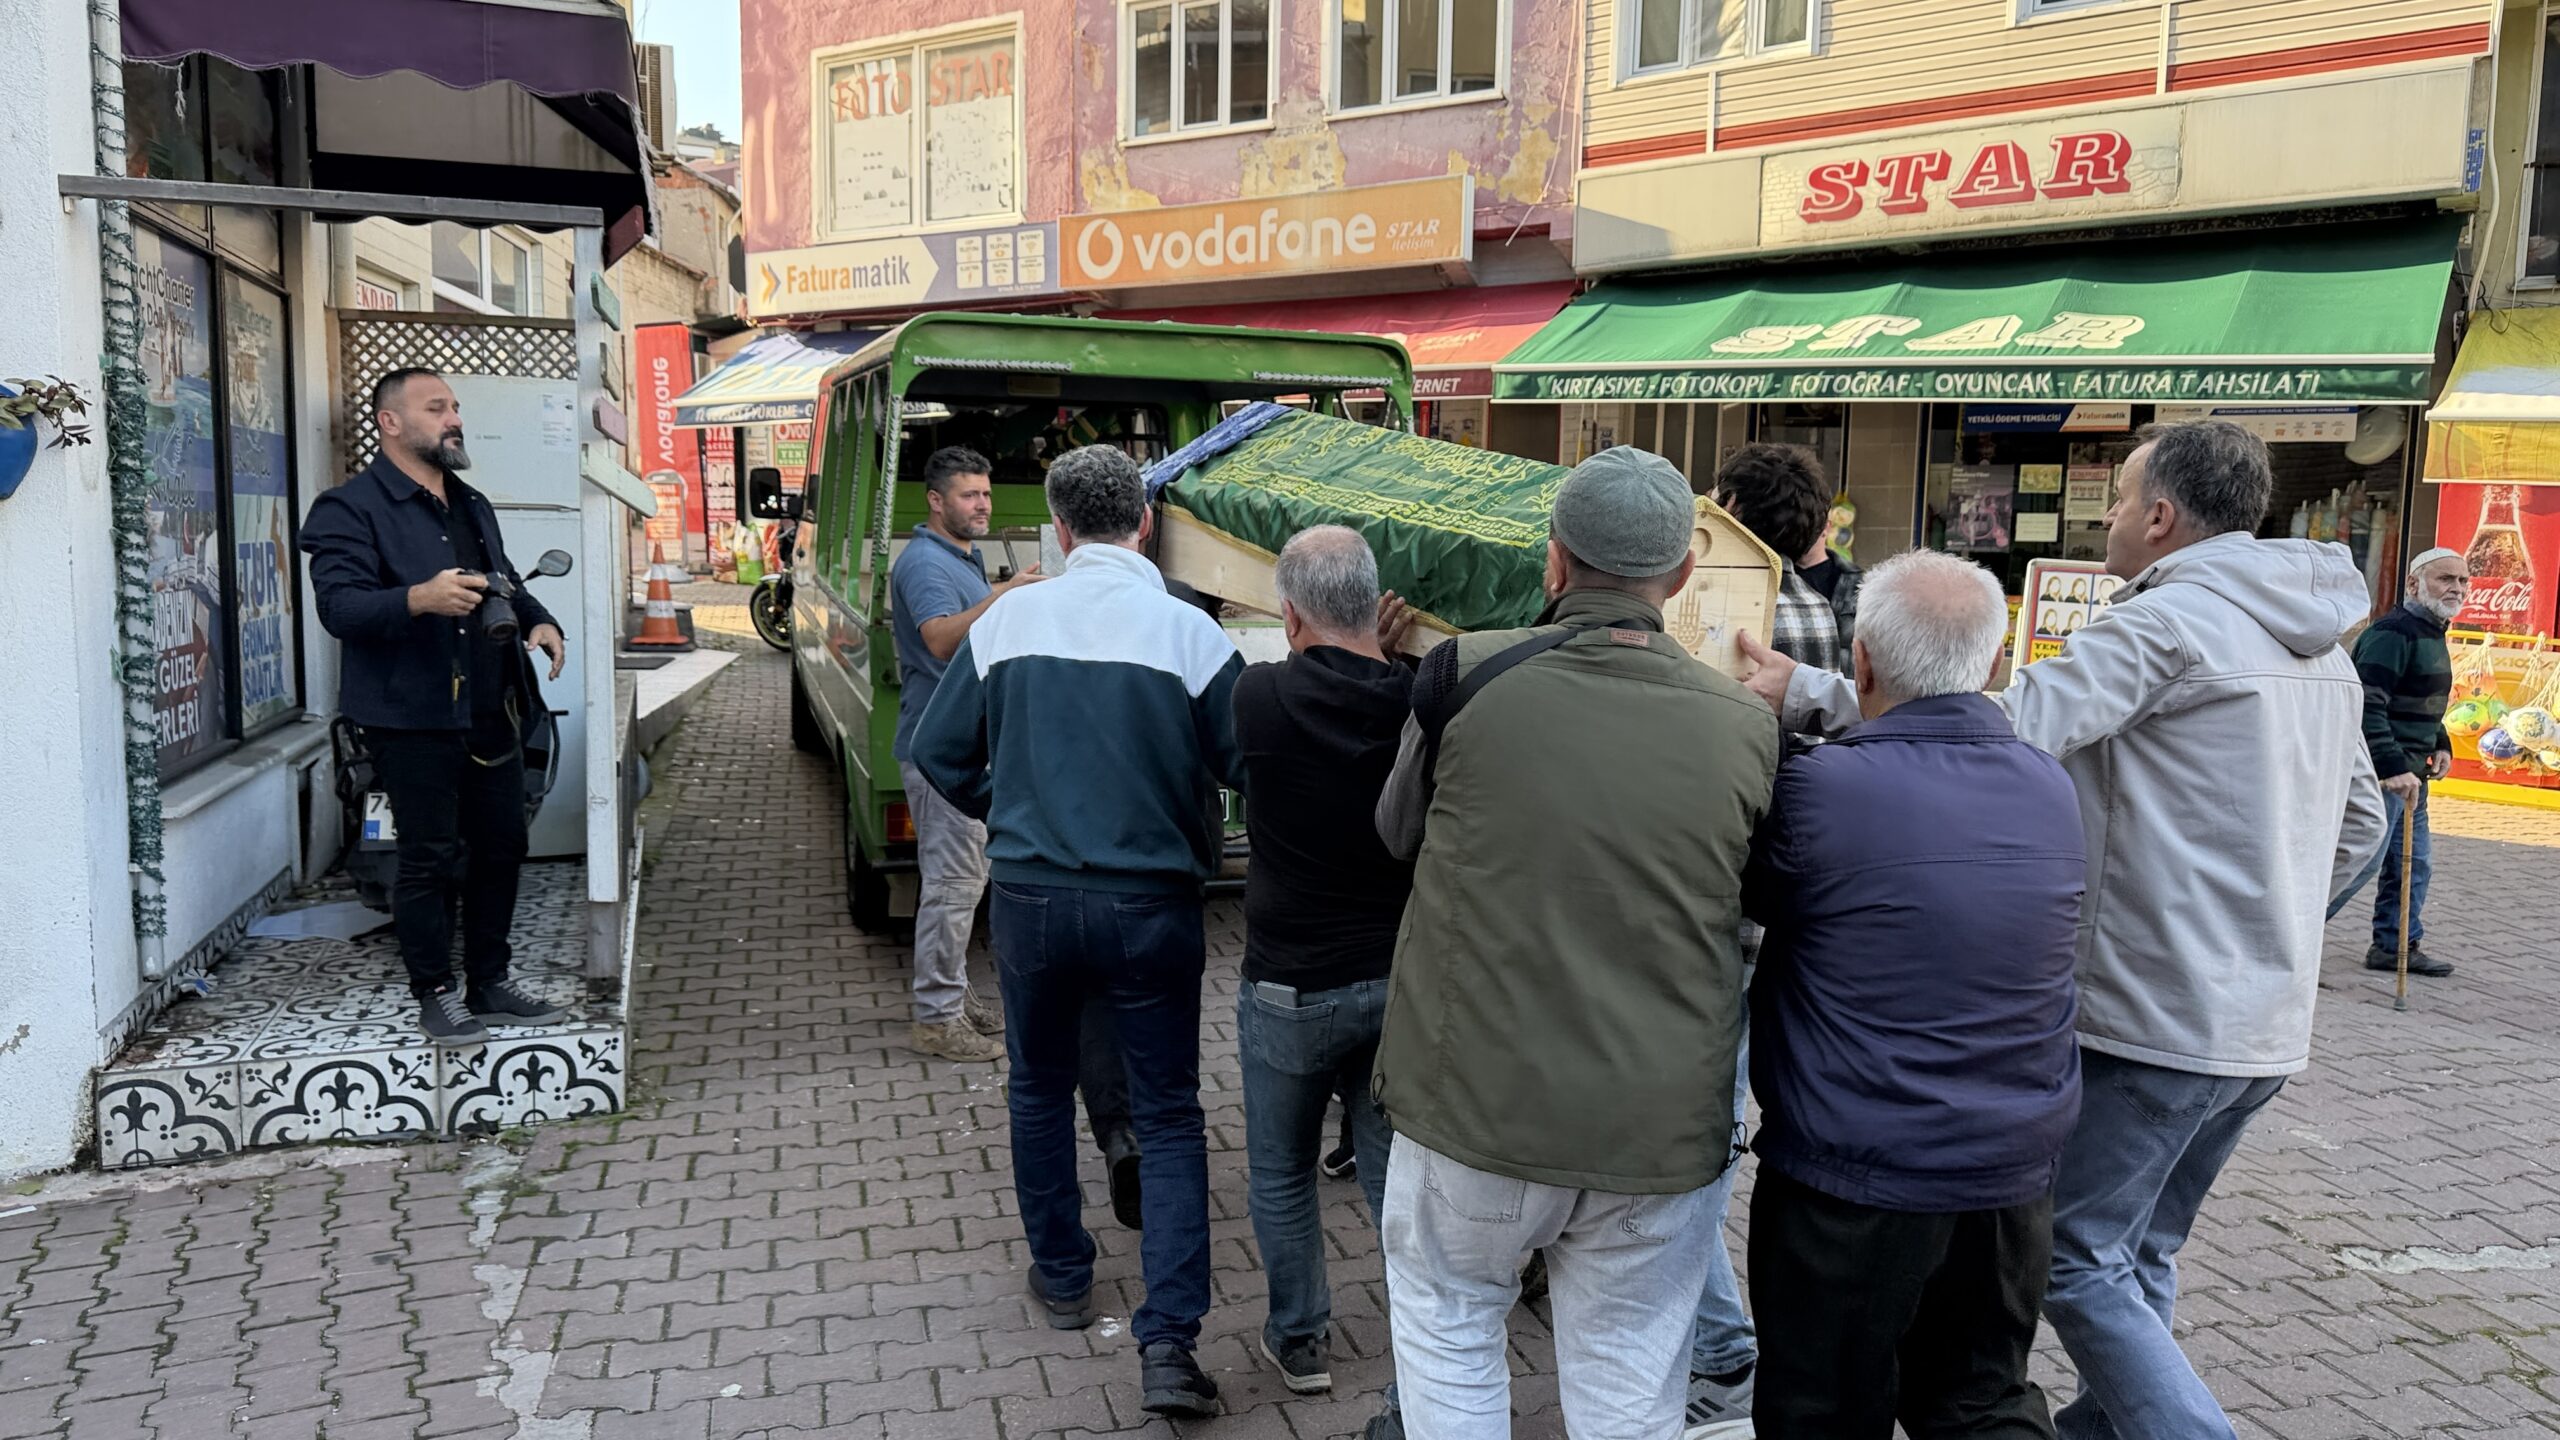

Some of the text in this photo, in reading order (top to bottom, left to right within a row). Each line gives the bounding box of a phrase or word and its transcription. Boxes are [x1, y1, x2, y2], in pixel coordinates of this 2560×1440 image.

[834, 51, 1013, 123] FOTO STAR
[1798, 128, 2133, 225] STAR
[1133, 208, 1376, 271] vodafone
[1385, 218, 1440, 239] STAR
[786, 255, 911, 294] Faturamatik
[1710, 311, 2145, 353] STAR
[1412, 376, 1461, 393] ERNET
[1790, 370, 1911, 393] FOTOĞRAF
[1934, 372, 2051, 393] OYUNCAK
[2072, 372, 2172, 394] FATURA
[653, 356, 676, 465] vodafone
[1996, 413, 2021, 424] ÖDEME
[238, 541, 278, 609] TUR
[242, 614, 282, 662] GÜNLÜK
[160, 651, 198, 695] GÜZEL
